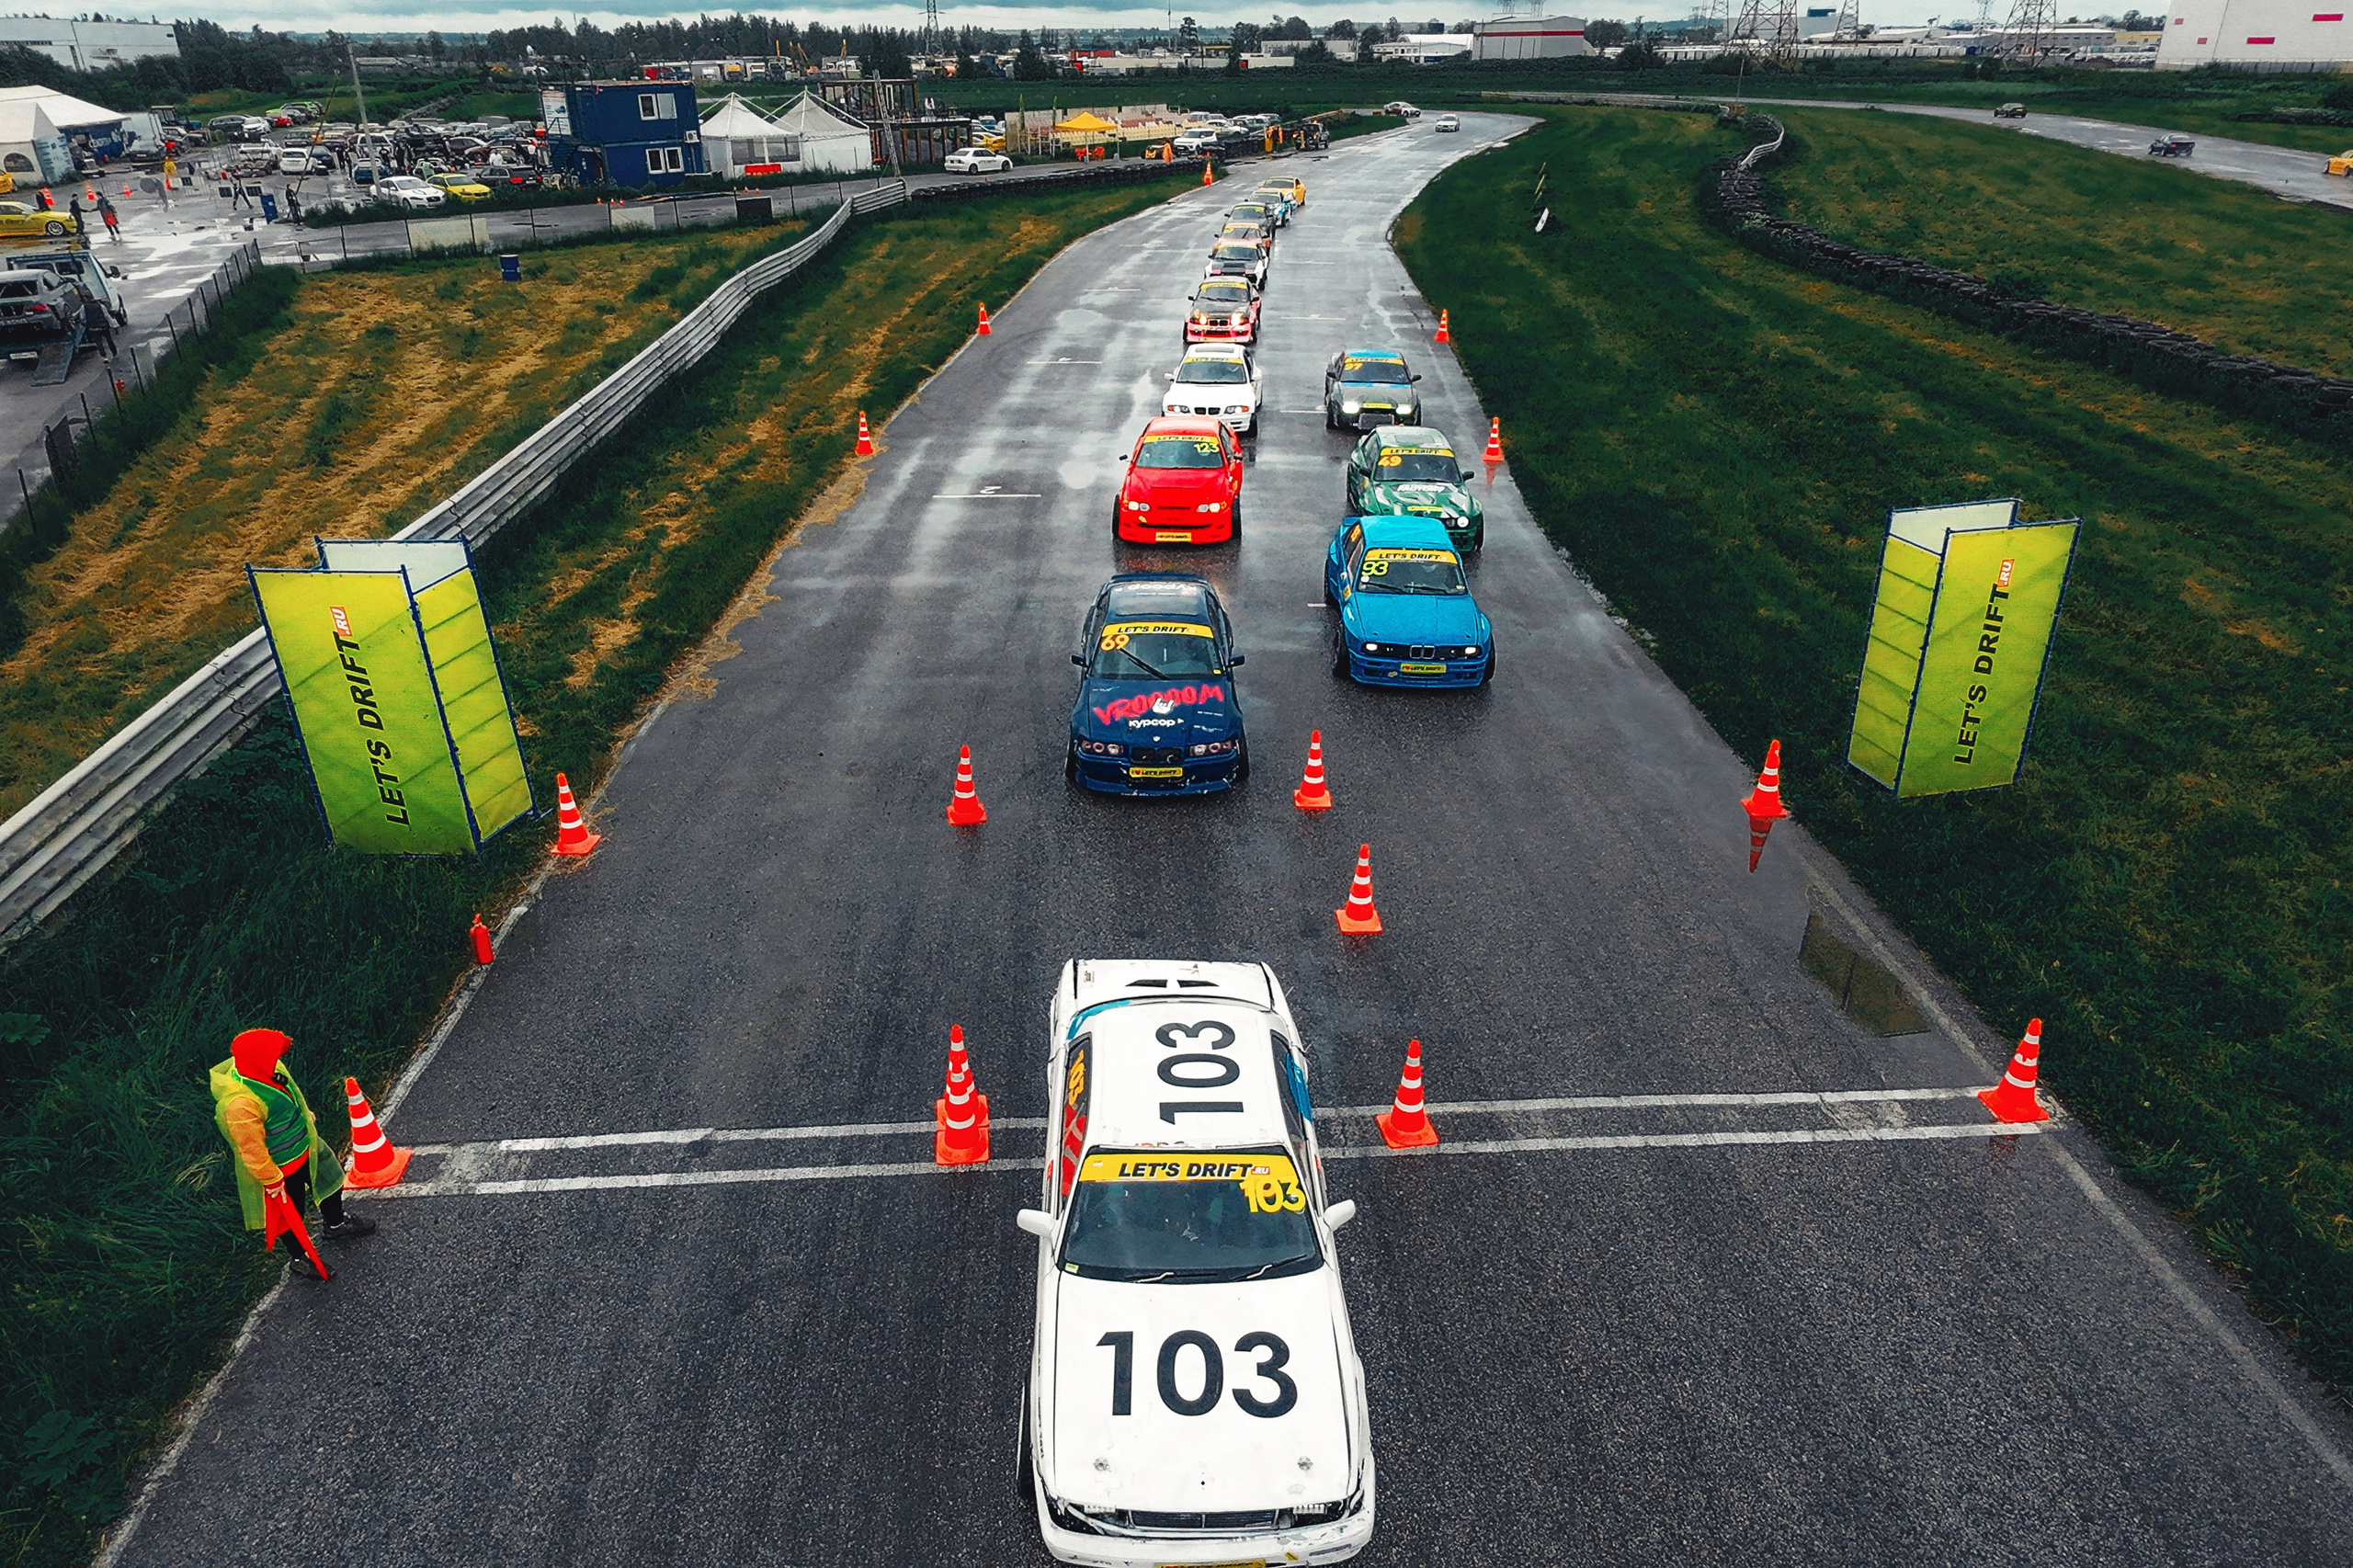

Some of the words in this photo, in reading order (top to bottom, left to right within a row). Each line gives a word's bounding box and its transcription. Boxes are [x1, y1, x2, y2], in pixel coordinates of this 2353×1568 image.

[1193, 443, 1220, 453] 123
[1361, 560, 1389, 576] 93
[1117, 625, 1150, 633] LET'S
[1099, 634, 1131, 652] 69
[1128, 719, 1176, 729] курсор
[1953, 683, 1987, 765] LET'S
[367, 739, 410, 825] LET'S
[1155, 1019, 1244, 1127] 103
[1119, 1163, 1180, 1178] LET'S
[1239, 1176, 1307, 1214] 103
[1095, 1329, 1299, 1419] 103
